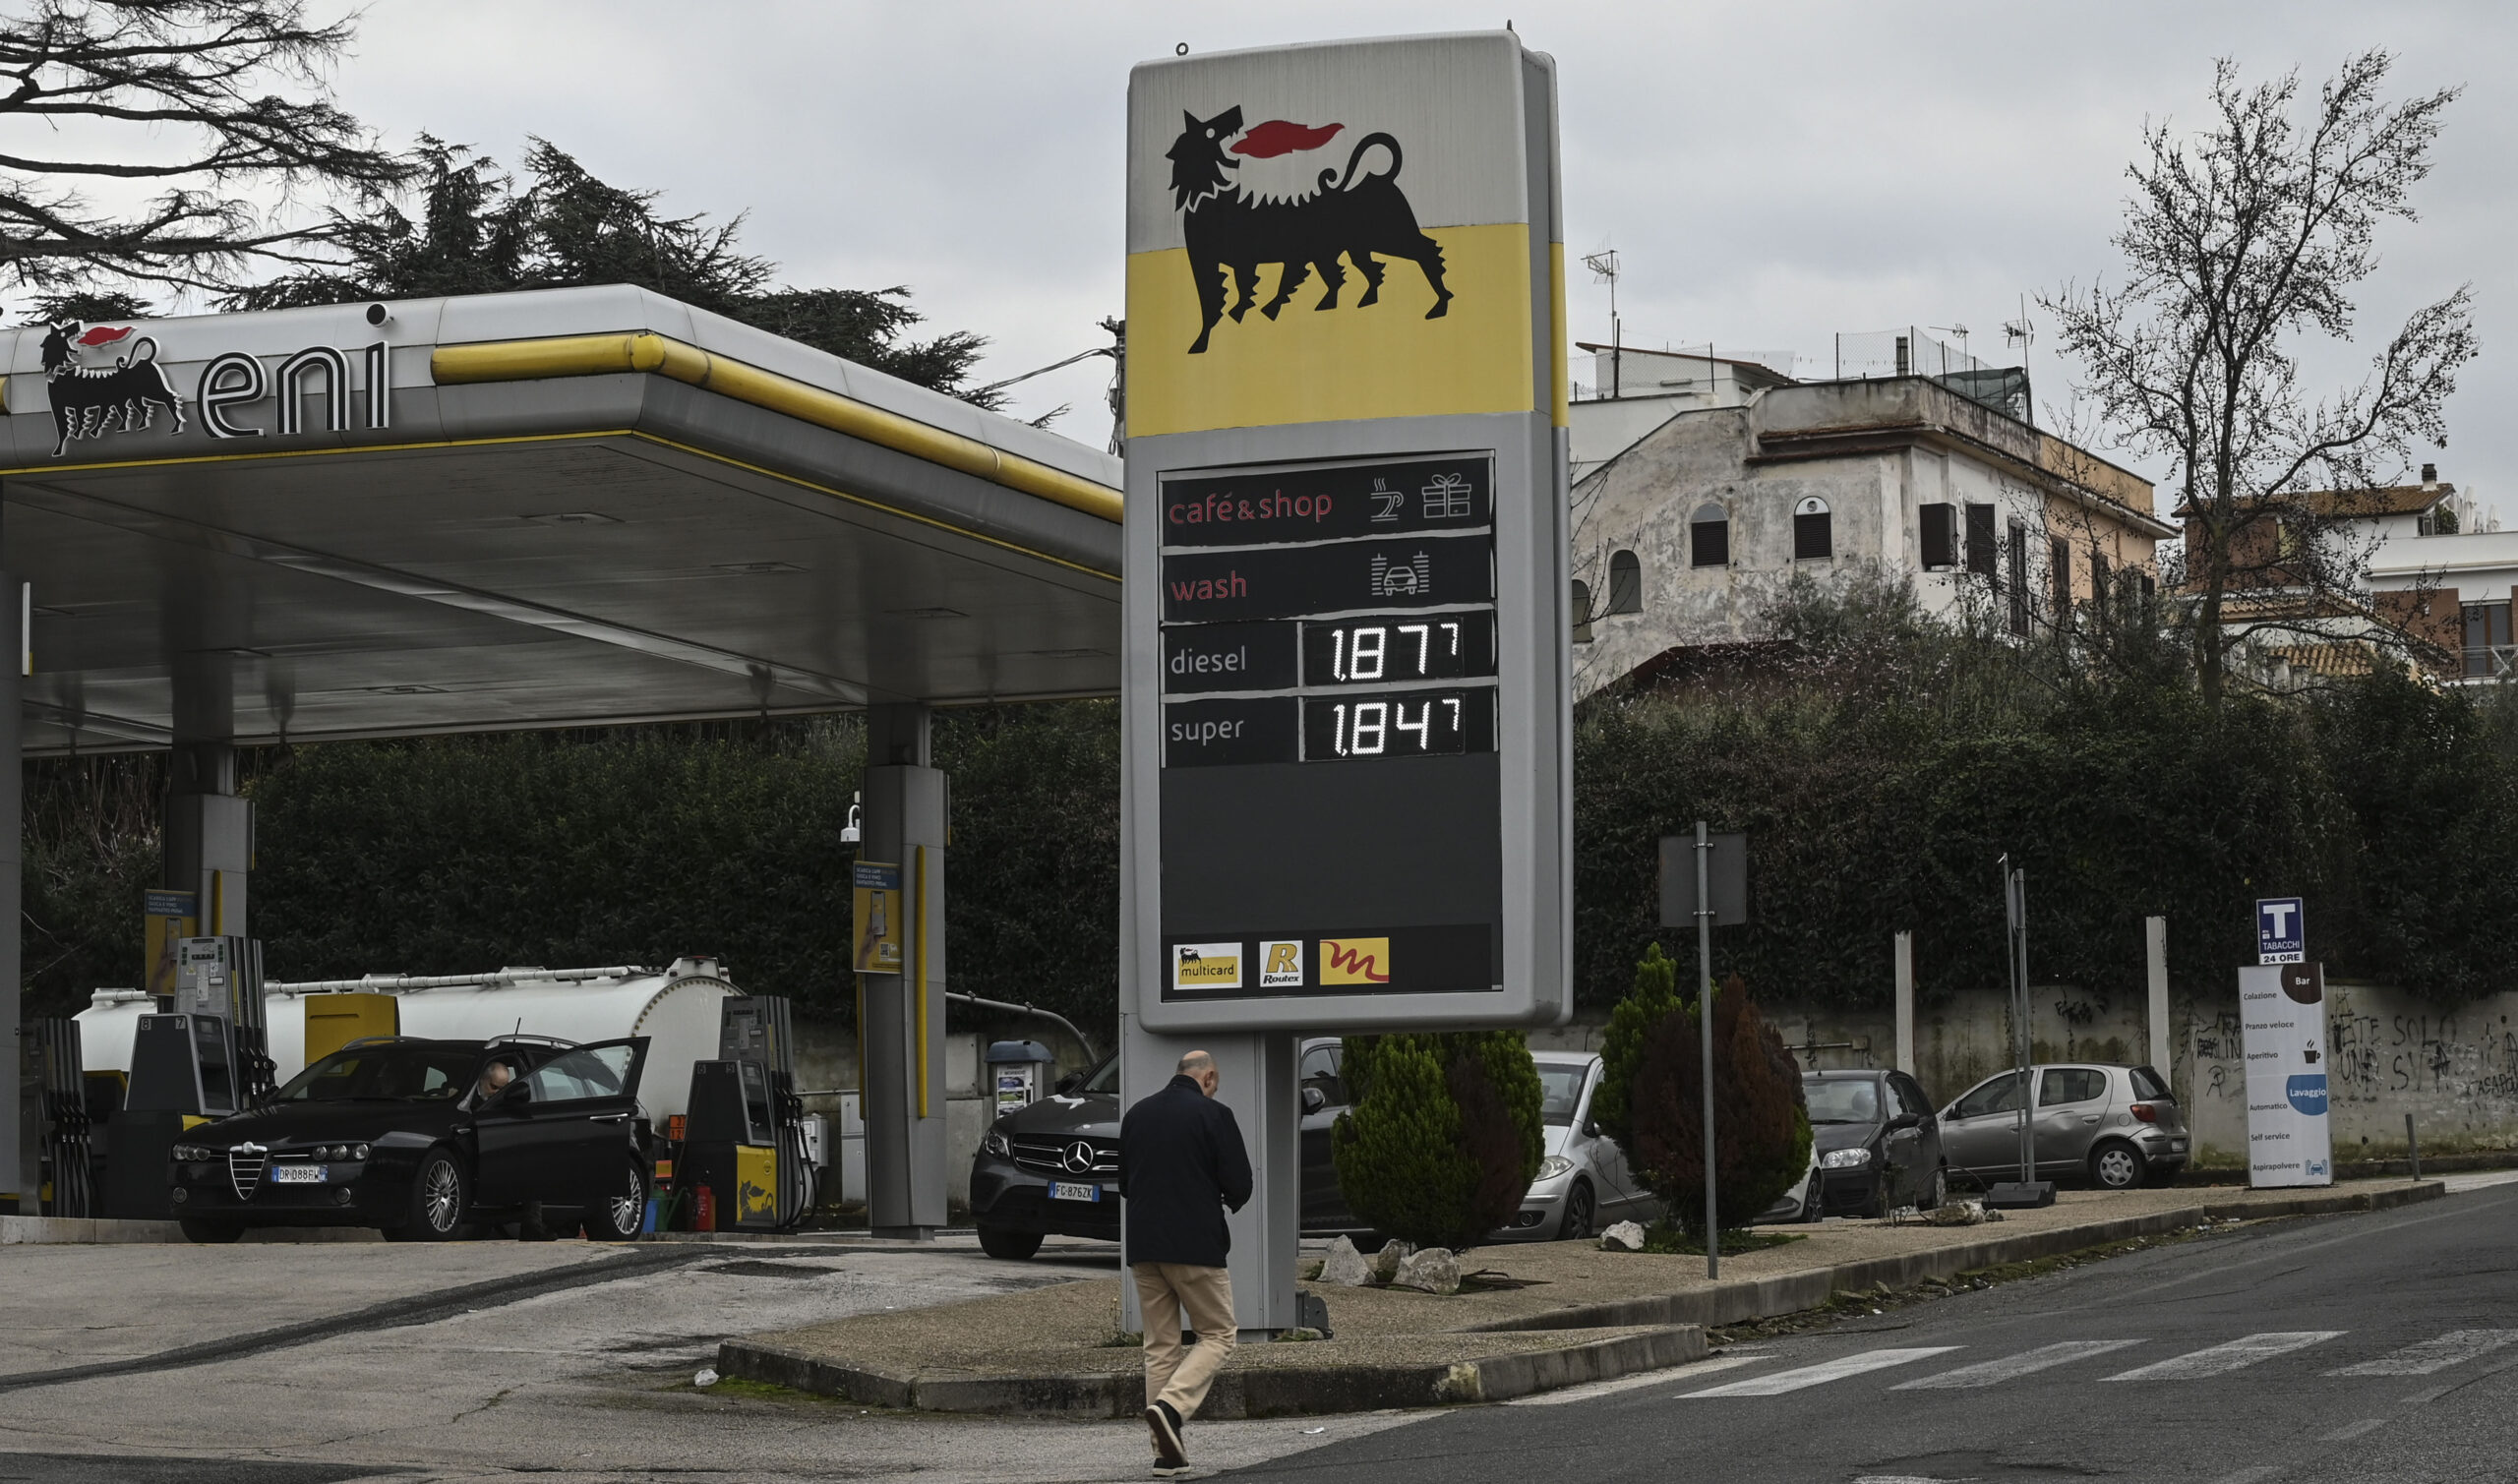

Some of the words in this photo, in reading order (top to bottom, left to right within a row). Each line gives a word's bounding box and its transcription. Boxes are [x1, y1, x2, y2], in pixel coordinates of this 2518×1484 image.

[199, 302, 390, 439] eni
[1170, 570, 1247, 601] wash
[1170, 645, 1247, 675] diesel
[1170, 720, 1244, 746] super
[2262, 903, 2296, 939] T
[2262, 940, 2301, 951] TABACCHI
[2279, 953, 2301, 962] ORE
[1180, 964, 1234, 978] multicard
[1263, 974, 1299, 984] Routex
[2295, 976, 2310, 985] Bar
[2244, 990, 2278, 1001] Colazione
[143, 1019, 150, 1030] 8
[177, 1018, 184, 1029] 7
[2245, 1021, 2268, 1031] Pranzo
[2269, 1020, 2295, 1030] veloce
[2247, 1050, 2279, 1062] Aperitivo
[2290, 1088, 2327, 1098] Lavaggio
[2249, 1101, 2288, 1111] Automatico
[2250, 1132, 2263, 1142] Self
[2264, 1132, 2291, 1141] service
[2252, 1160, 2301, 1172] Aspirapolvere
[279, 1168, 289, 1180] DR
